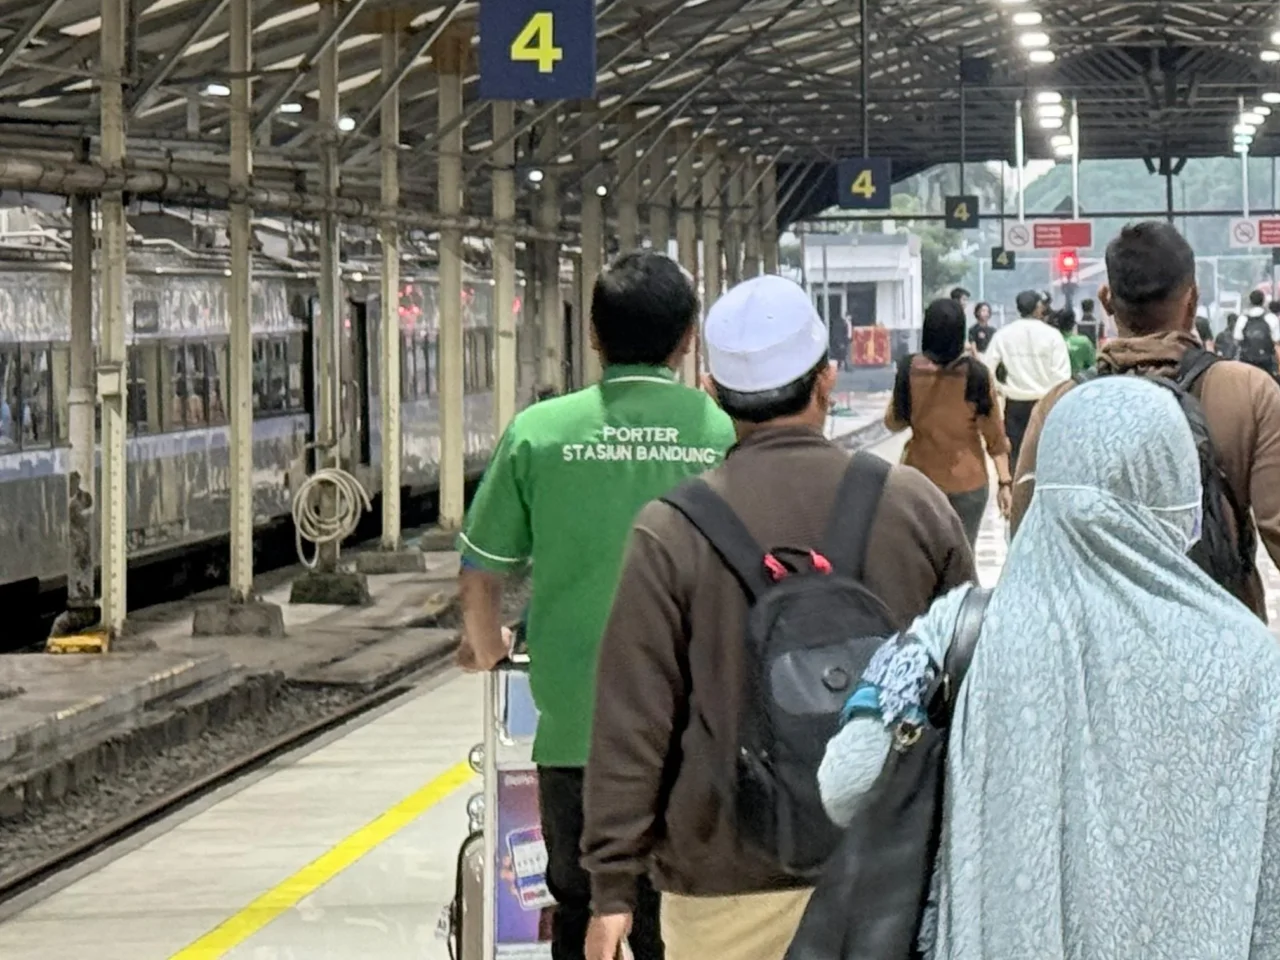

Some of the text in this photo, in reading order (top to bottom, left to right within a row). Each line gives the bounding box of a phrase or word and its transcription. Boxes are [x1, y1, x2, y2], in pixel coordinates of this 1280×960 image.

[510, 12, 562, 73] 4
[850, 169, 875, 198] 4
[952, 202, 970, 222] 4
[602, 426, 680, 443] PORTER
[562, 444, 716, 464] STASIUN BANDUNG
